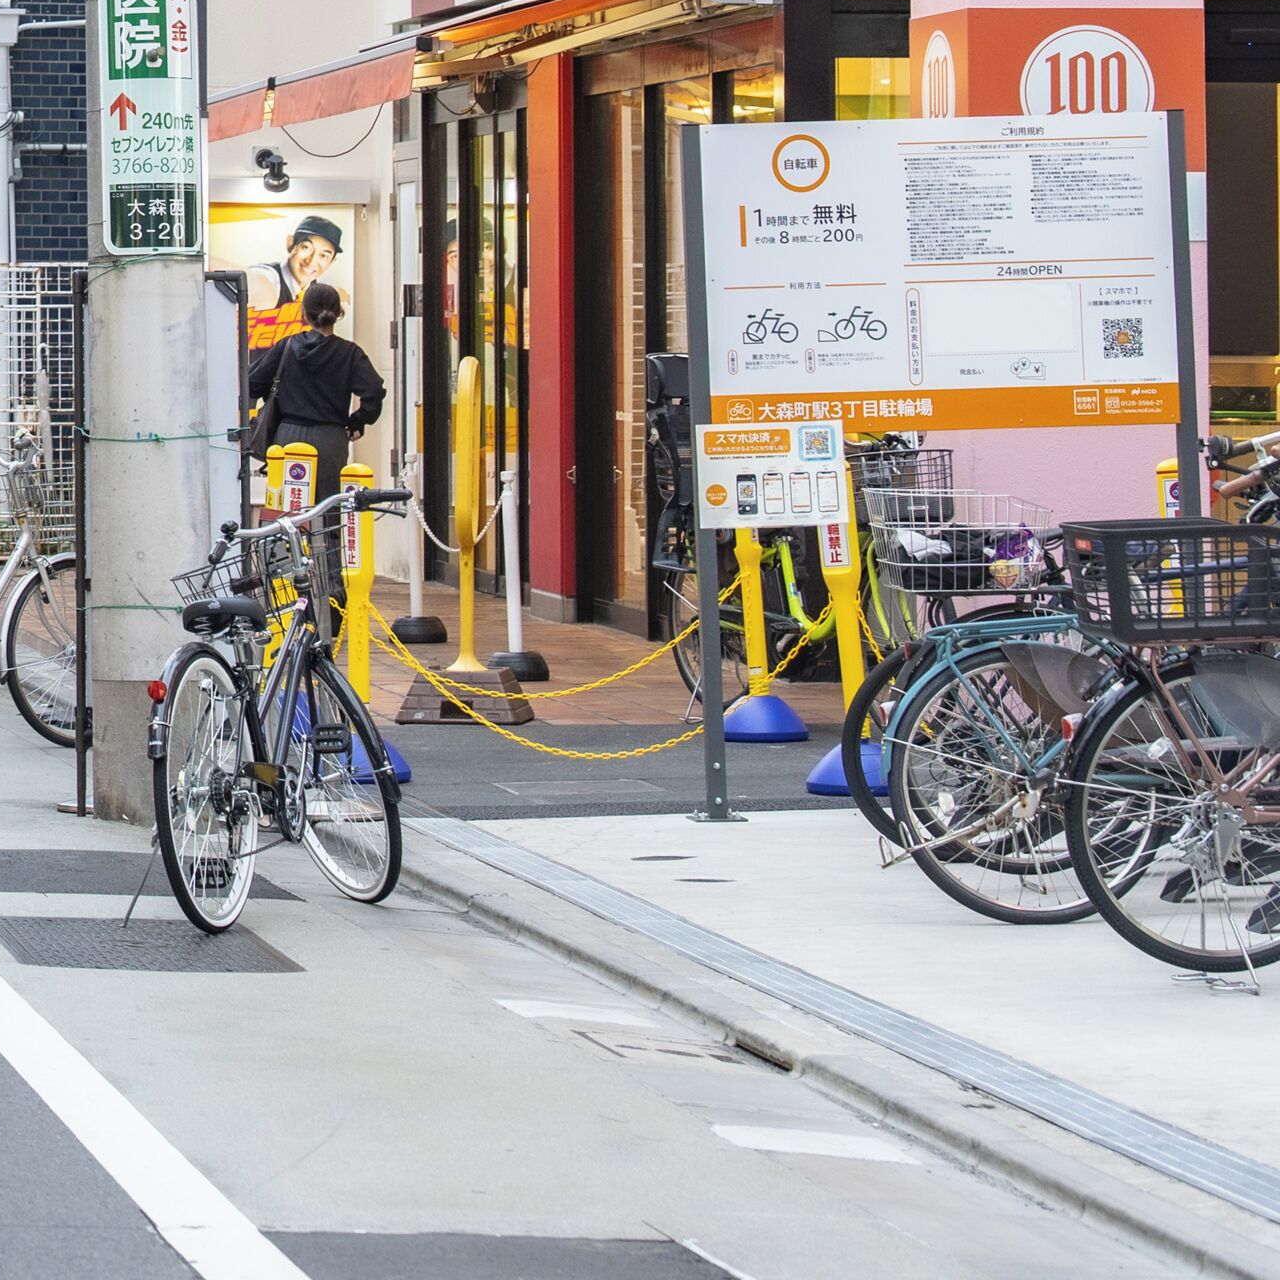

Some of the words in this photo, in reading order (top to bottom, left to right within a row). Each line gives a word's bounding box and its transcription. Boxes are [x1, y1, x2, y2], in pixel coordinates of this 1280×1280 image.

[928, 55, 948, 119] 100
[1045, 51, 1127, 115] 100
[142, 112, 194, 130] 240m先
[1001, 127, 1045, 136] ご利用規約
[111, 136, 194, 154] セブンイレブン隣
[112, 157, 194, 175] 3766-8209
[784, 158, 818, 170] 自転車
[127, 198, 186, 217] 大森西
[129, 222, 186, 241] 3-20
[997, 265, 1063, 277] 24時間OPEN
[789, 282, 822, 290] 利用方法
[909, 300, 920, 376] 料金のお支払い方法
[758, 397, 934, 420] 大森町駅3丁目駐輪場
[1077, 402, 1097, 410] 6561
[716, 431, 770, 444] スマホ決済
